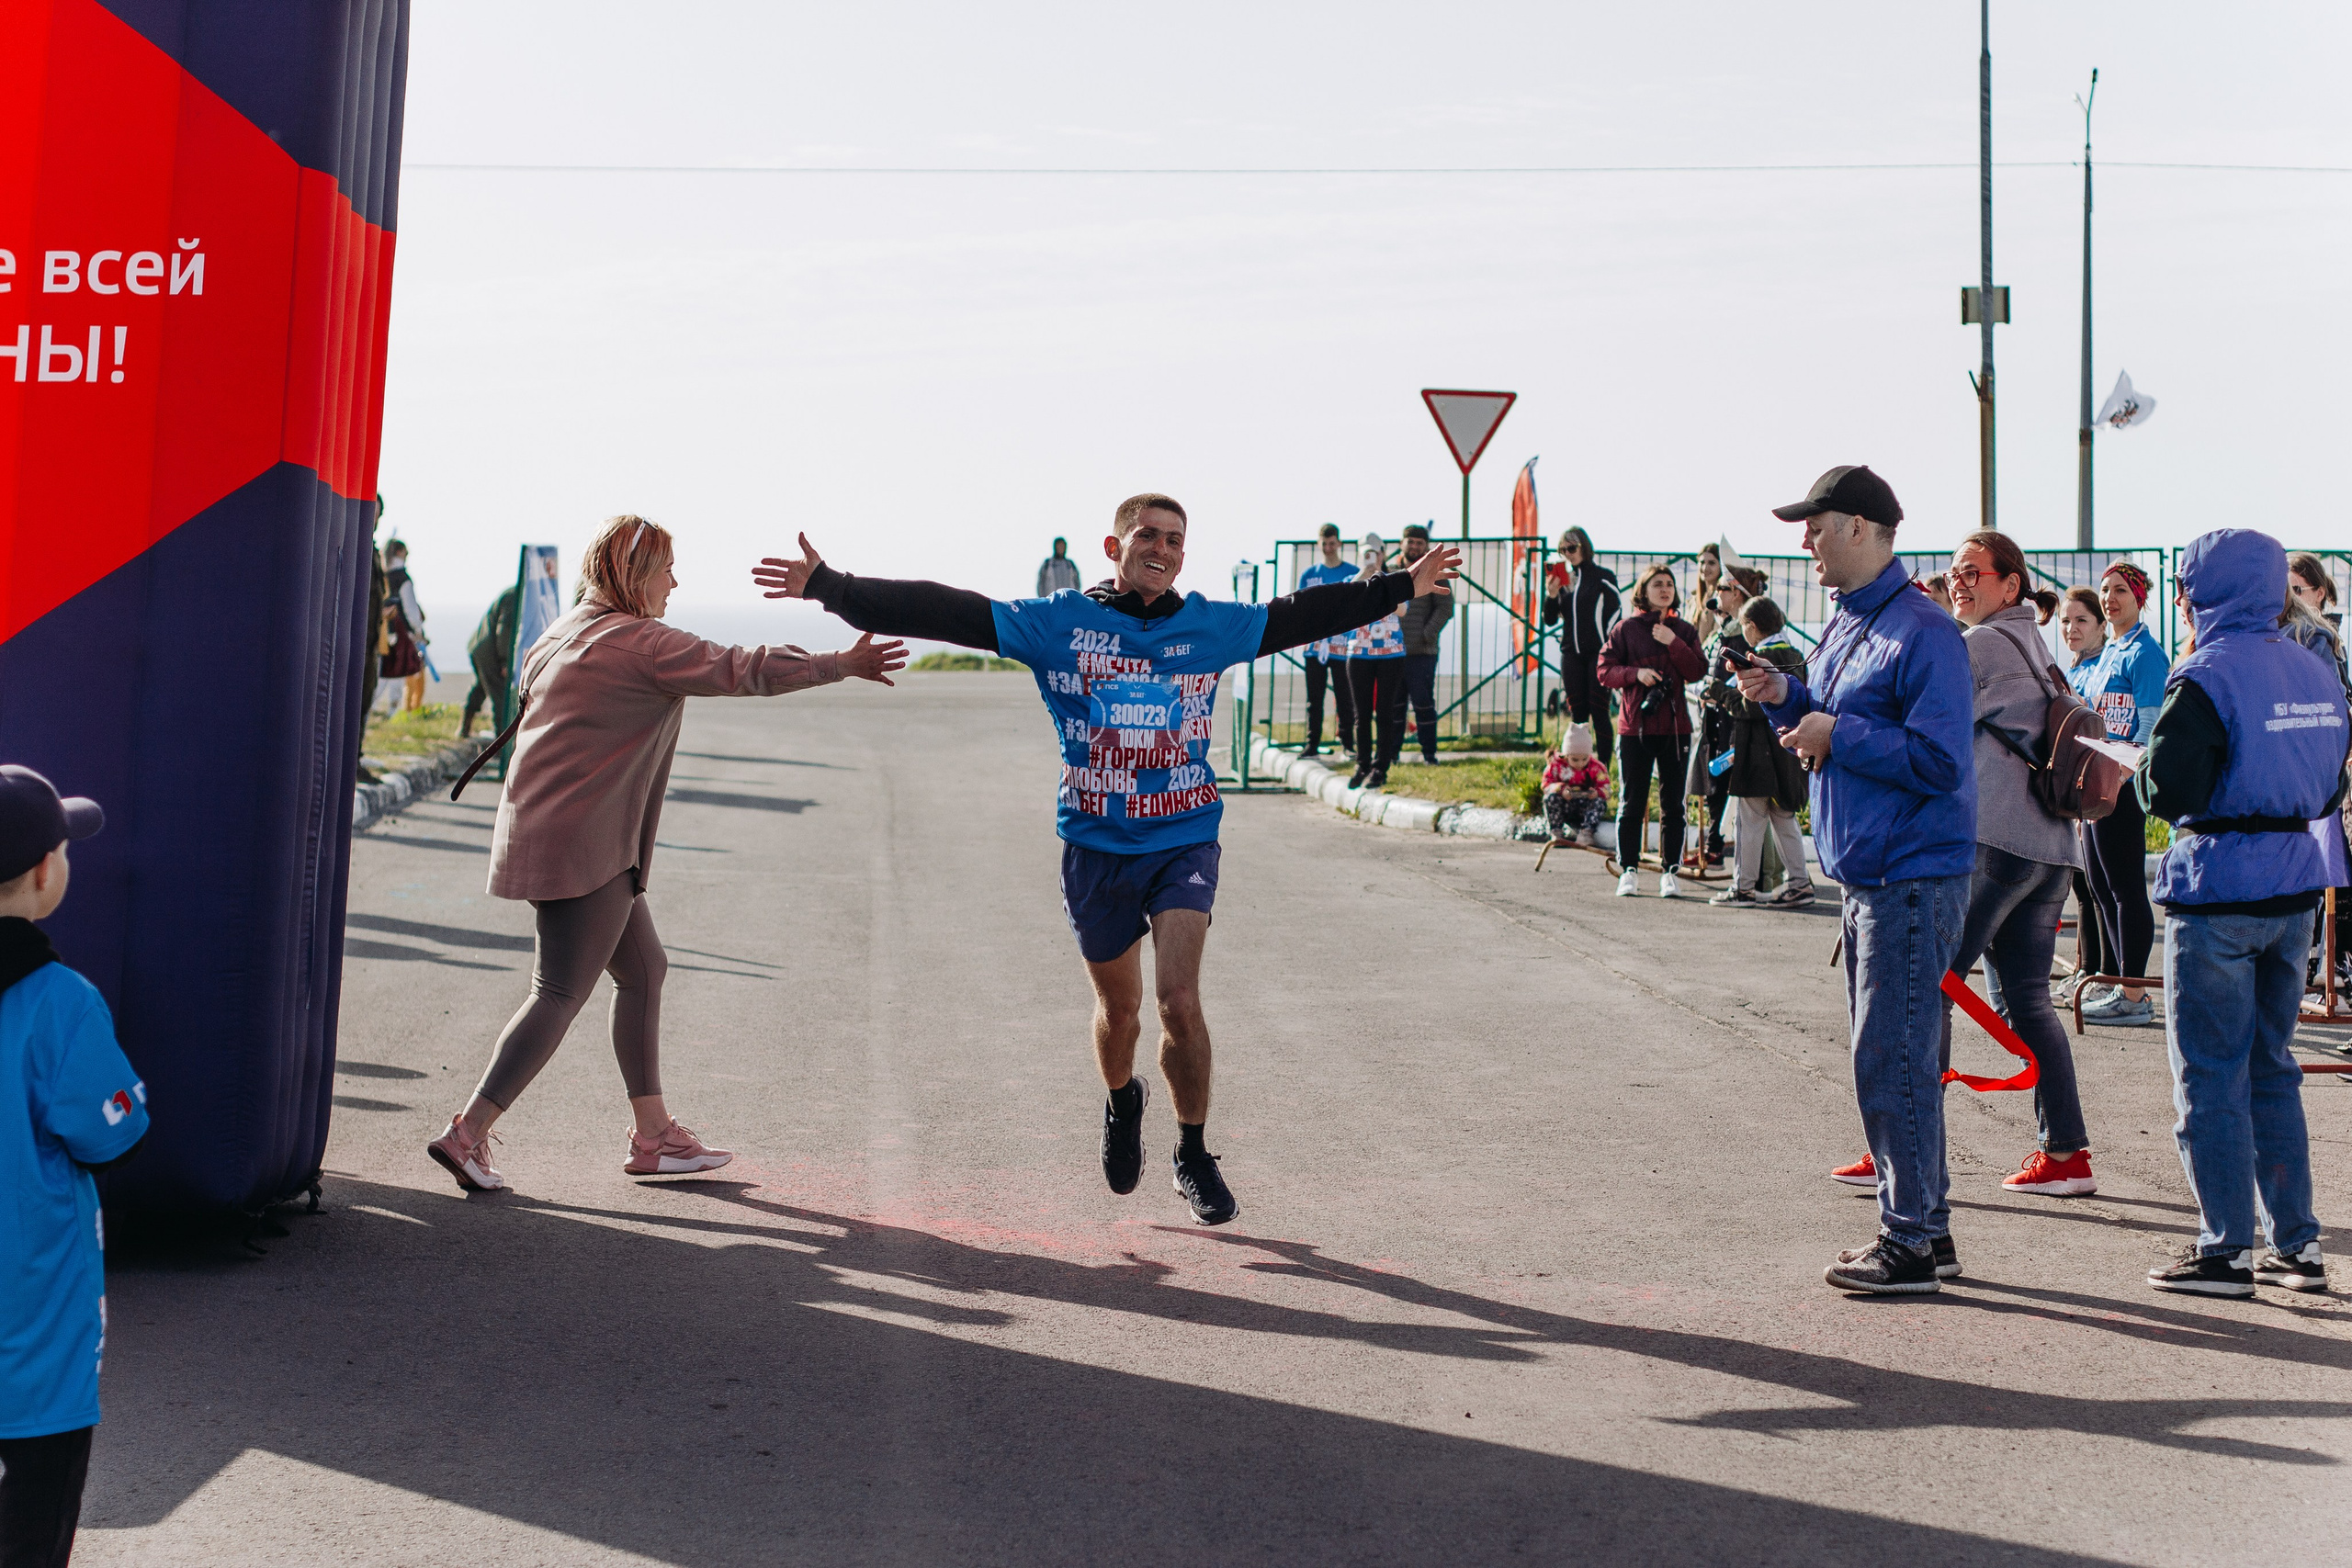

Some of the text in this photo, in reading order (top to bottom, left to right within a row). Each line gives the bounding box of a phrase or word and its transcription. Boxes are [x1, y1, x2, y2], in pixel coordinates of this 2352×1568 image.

[42, 237, 205, 296] всей
[1069, 627, 1122, 656] 2024
[1077, 651, 1152, 674] #МЕЧТА
[1109, 703, 1167, 728] 30023
[1117, 728, 1156, 749] 10КМ
[1089, 744, 1191, 770] #ГОРДОСТЬ
